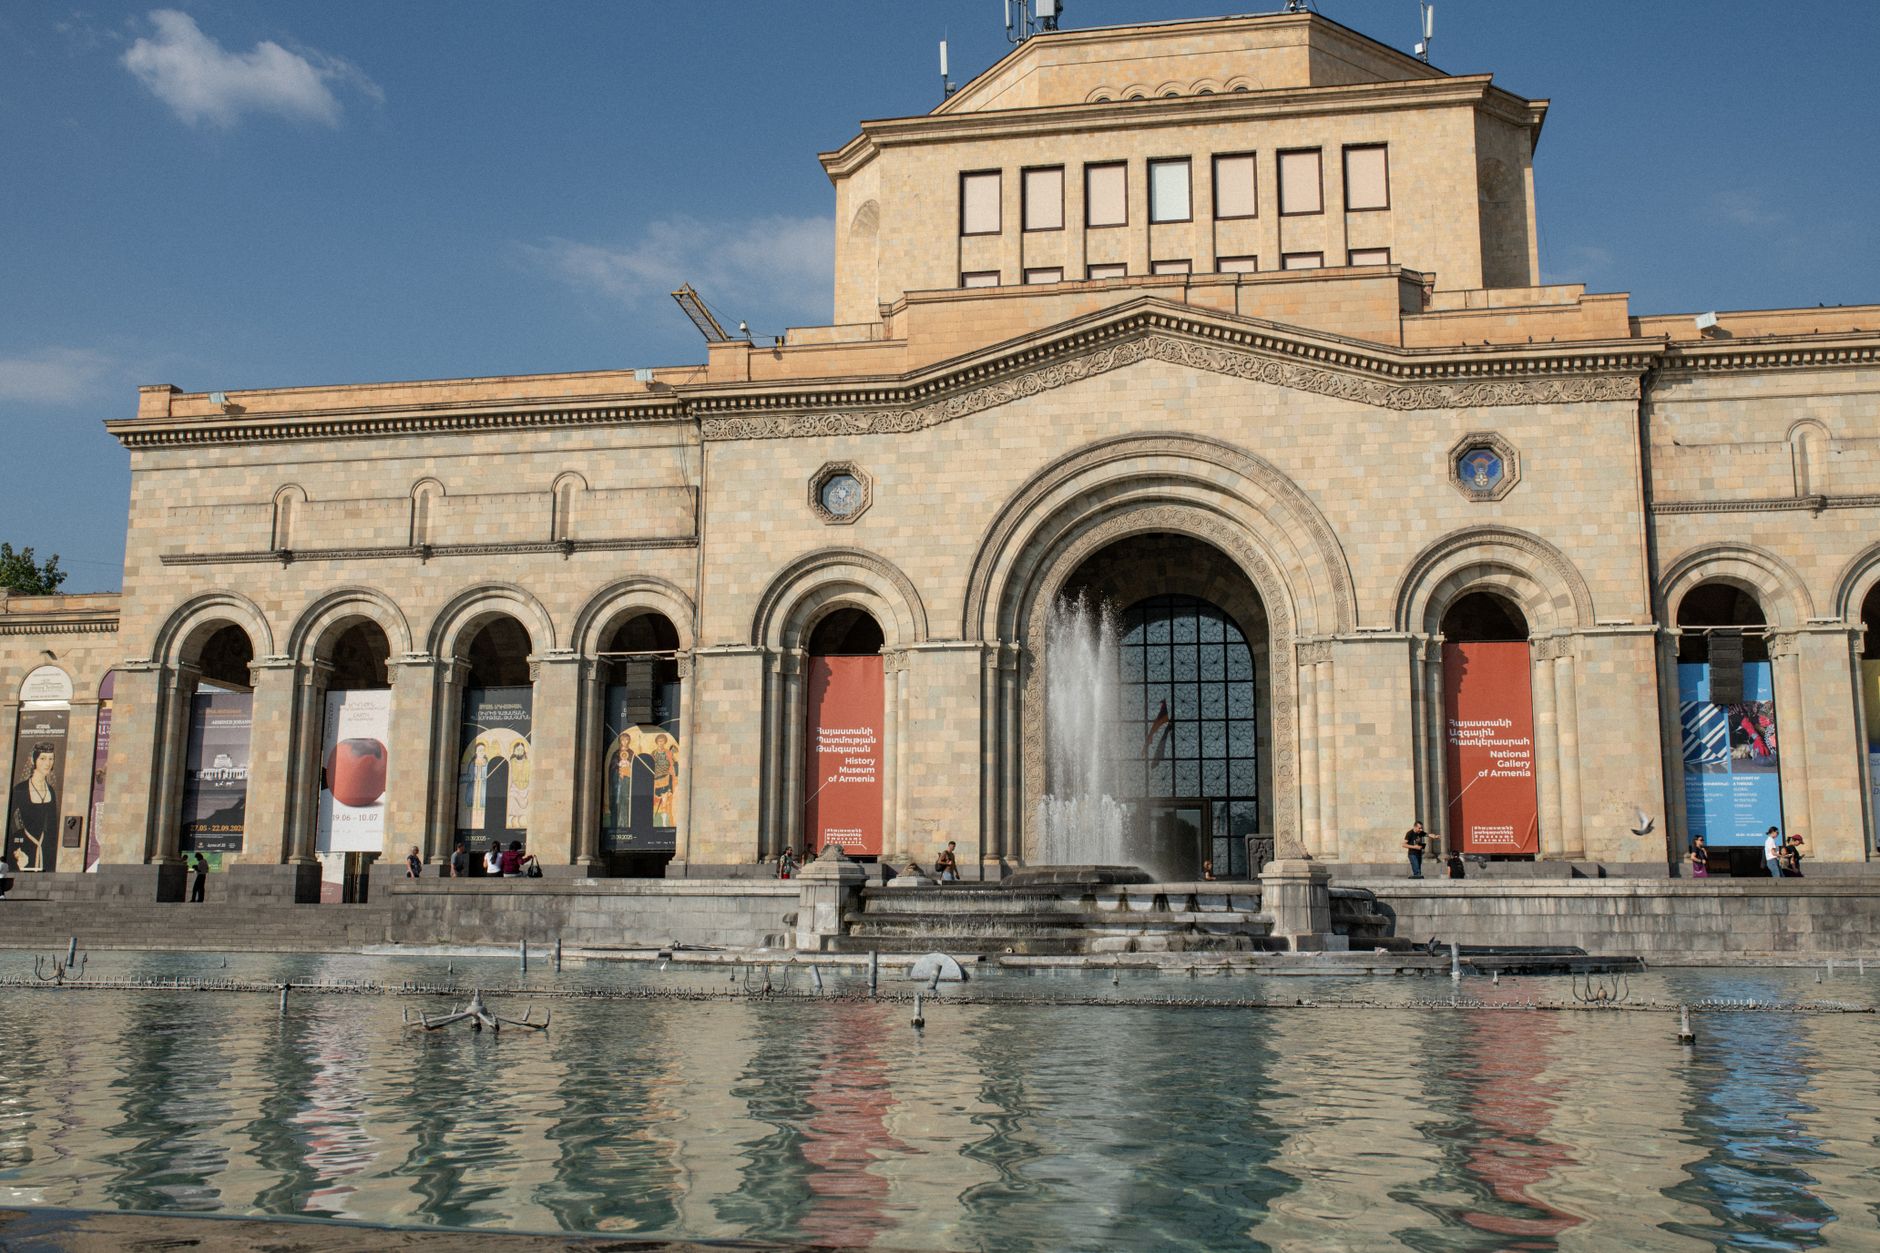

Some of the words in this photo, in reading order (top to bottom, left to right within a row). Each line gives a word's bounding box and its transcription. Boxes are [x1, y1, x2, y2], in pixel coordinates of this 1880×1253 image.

[1448, 718, 1512, 728] Հայաստանի
[816, 727, 873, 736] Հայաստանի
[1449, 728, 1495, 738] Ազգային
[816, 736, 877, 745] Պատմության
[1450, 737, 1530, 747] Պատկերասրահ
[816, 745, 871, 754] Թանգարան
[1490, 750, 1530, 758] National
[845, 757, 876, 766] History
[1497, 760, 1531, 769] Gallery
[839, 766, 875, 774] Museum
[1478, 769, 1488, 777] of
[1490, 769, 1531, 777] Armenia
[828, 775, 837, 783] of
[839, 775, 875, 783] Armenia
[359, 813, 378, 821] 10.07
